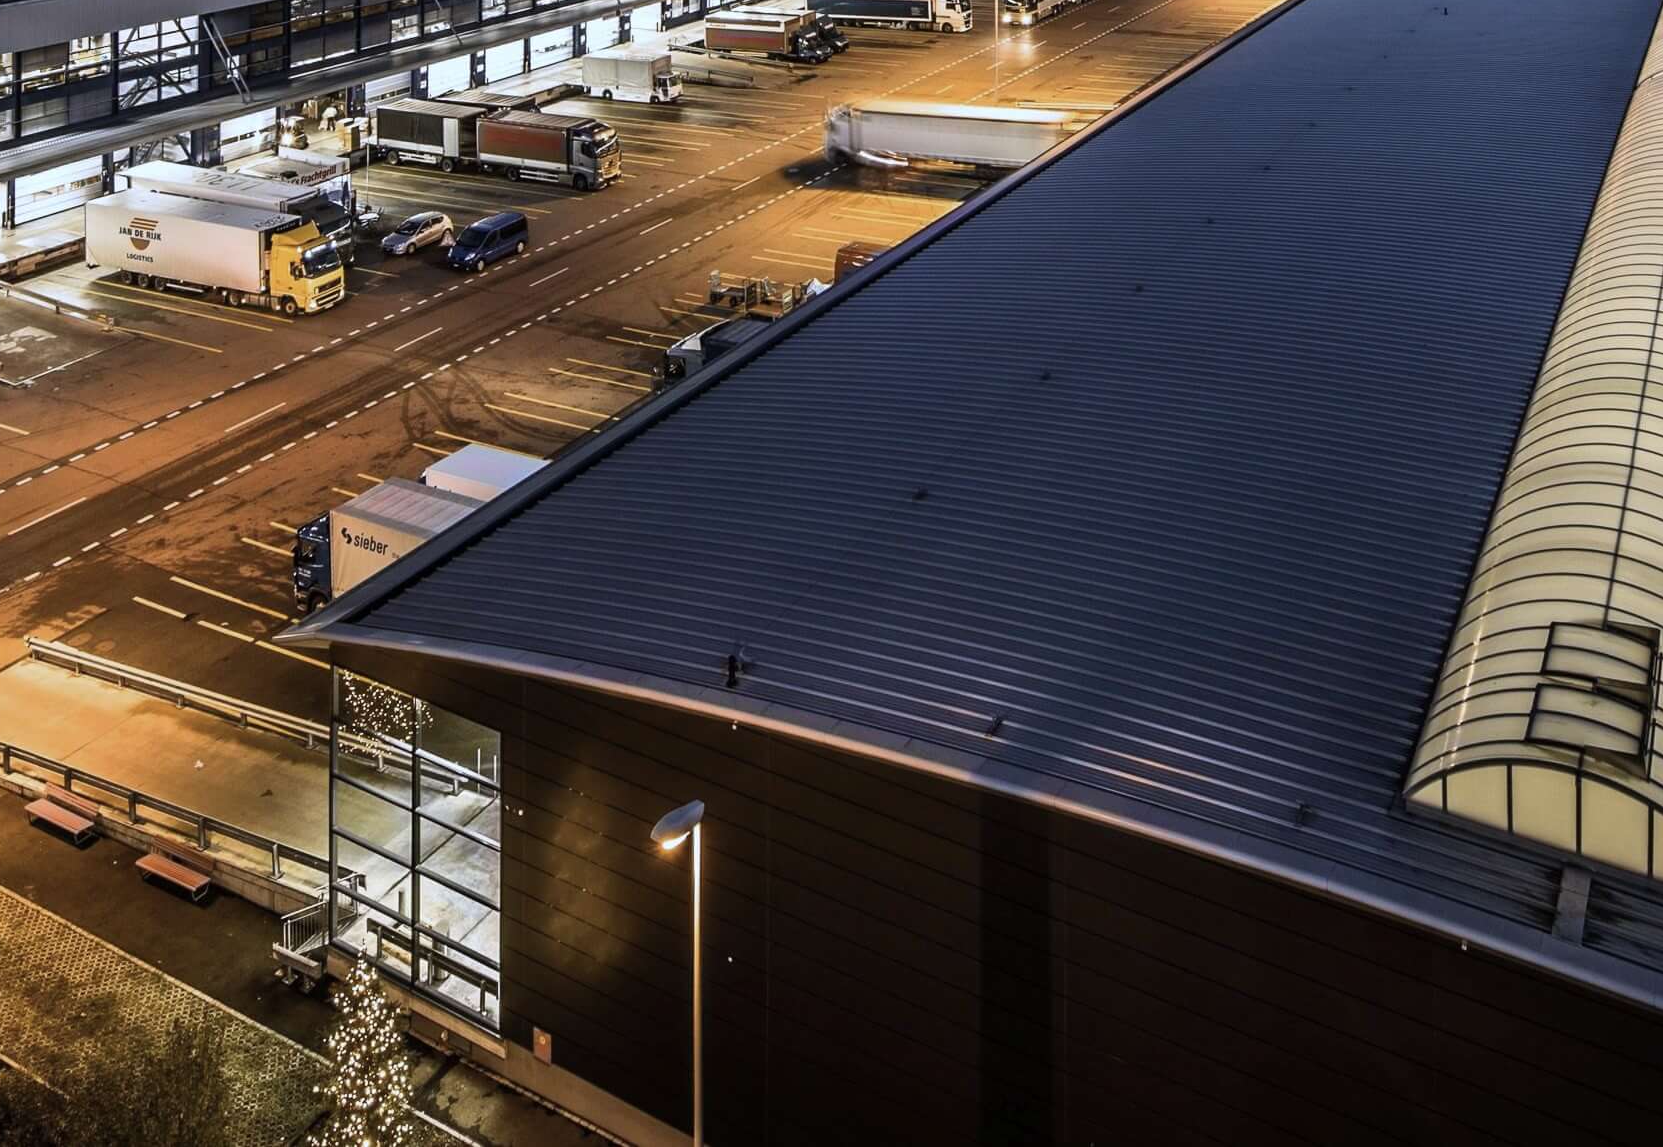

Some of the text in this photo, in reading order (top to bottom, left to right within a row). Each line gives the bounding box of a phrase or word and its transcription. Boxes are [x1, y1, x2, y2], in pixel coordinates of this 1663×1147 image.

[119, 226, 162, 241] JAN DE RIJK
[127, 253, 154, 263] LOGISTICS
[353, 532, 388, 555] sieber
